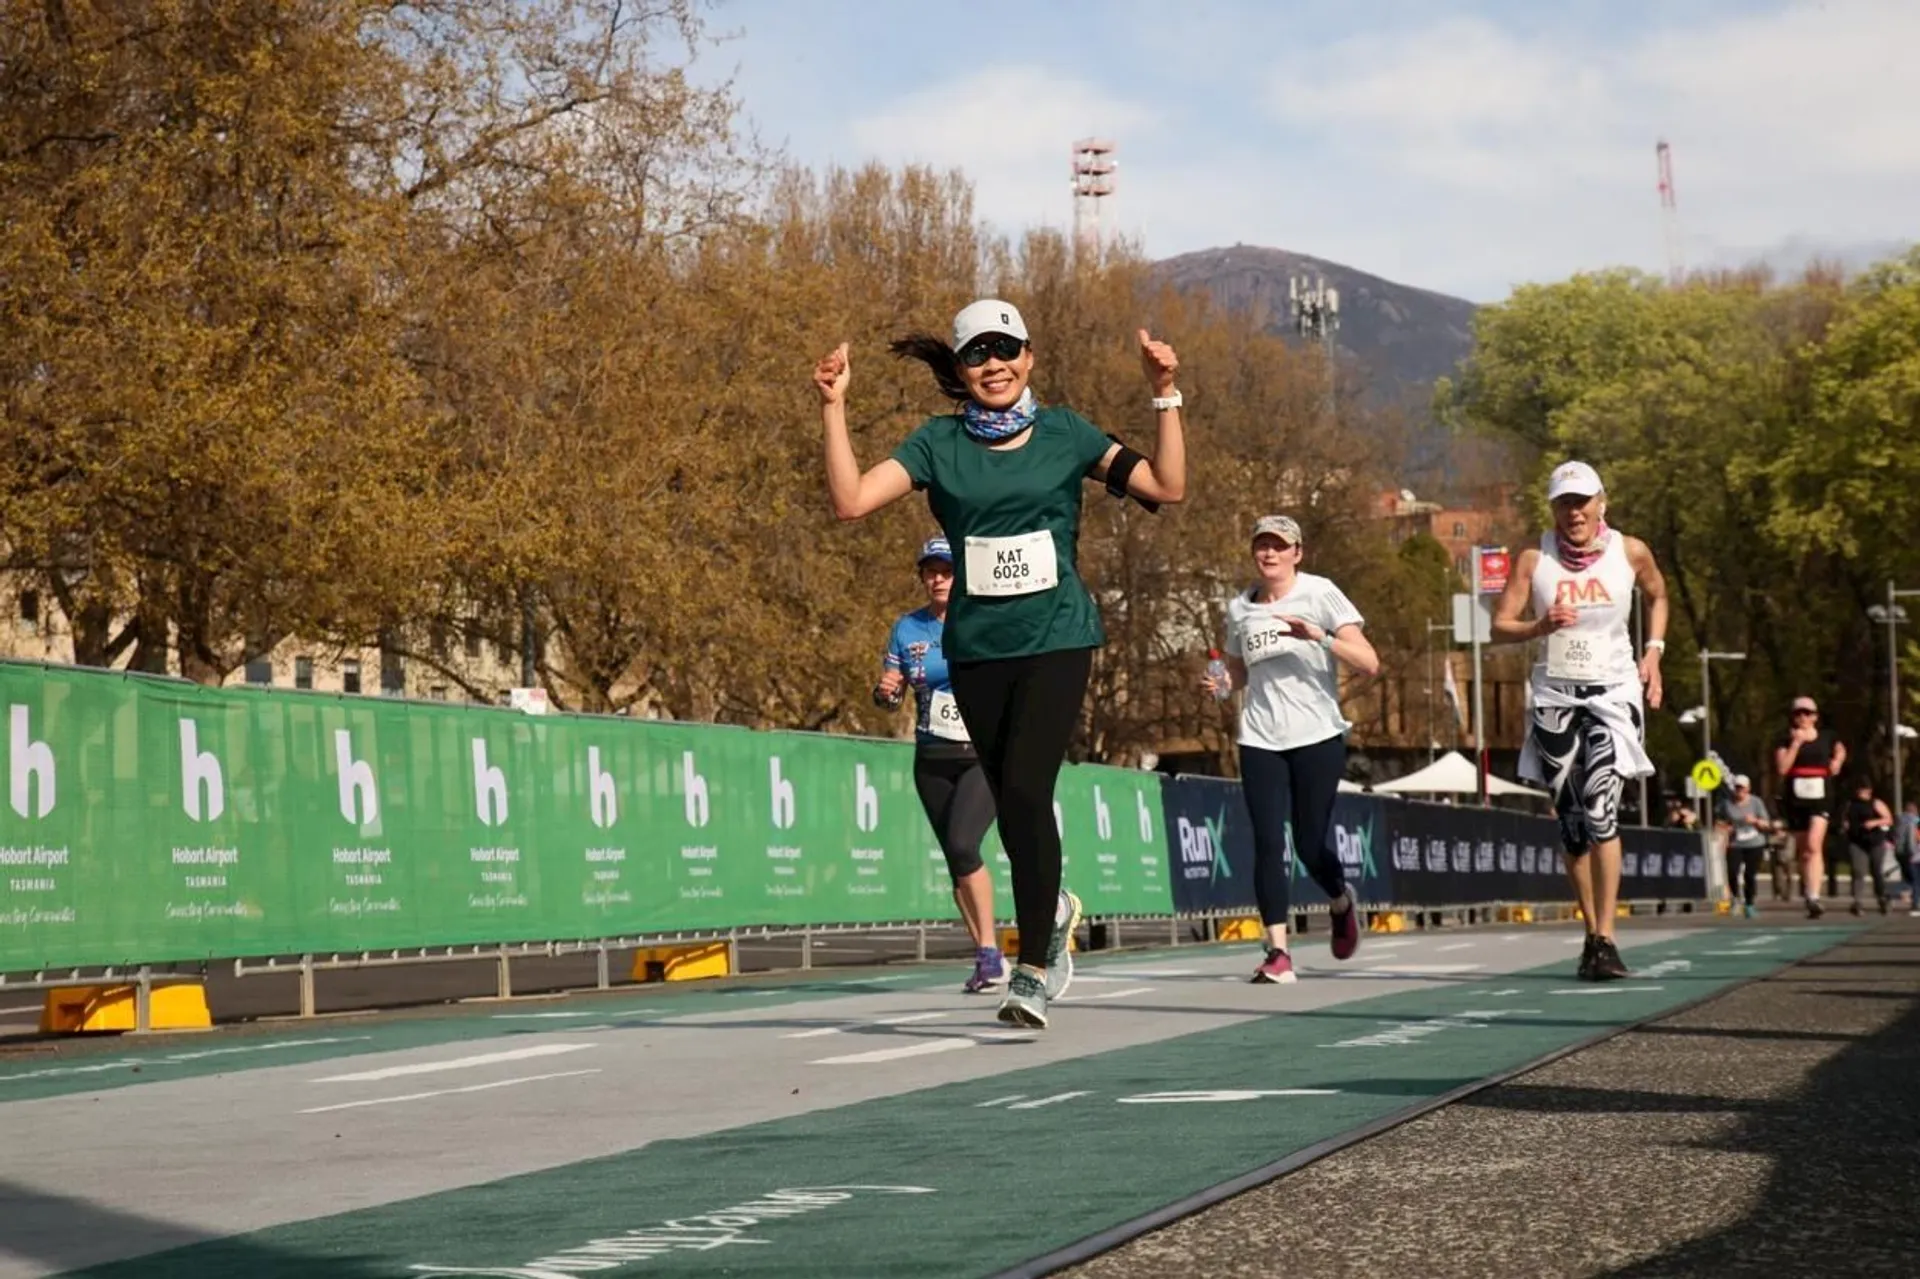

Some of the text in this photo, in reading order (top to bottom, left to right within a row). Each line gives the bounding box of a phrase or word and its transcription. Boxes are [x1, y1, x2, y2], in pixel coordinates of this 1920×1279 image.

[996, 549, 1023, 564] KAT
[993, 564, 1029, 579] 6028
[1247, 630, 1278, 652] 6375
[33, 844, 69, 869] Airport
[172, 846, 239, 868] Hobart Airport
[332, 846, 392, 867] Hobart Airport
